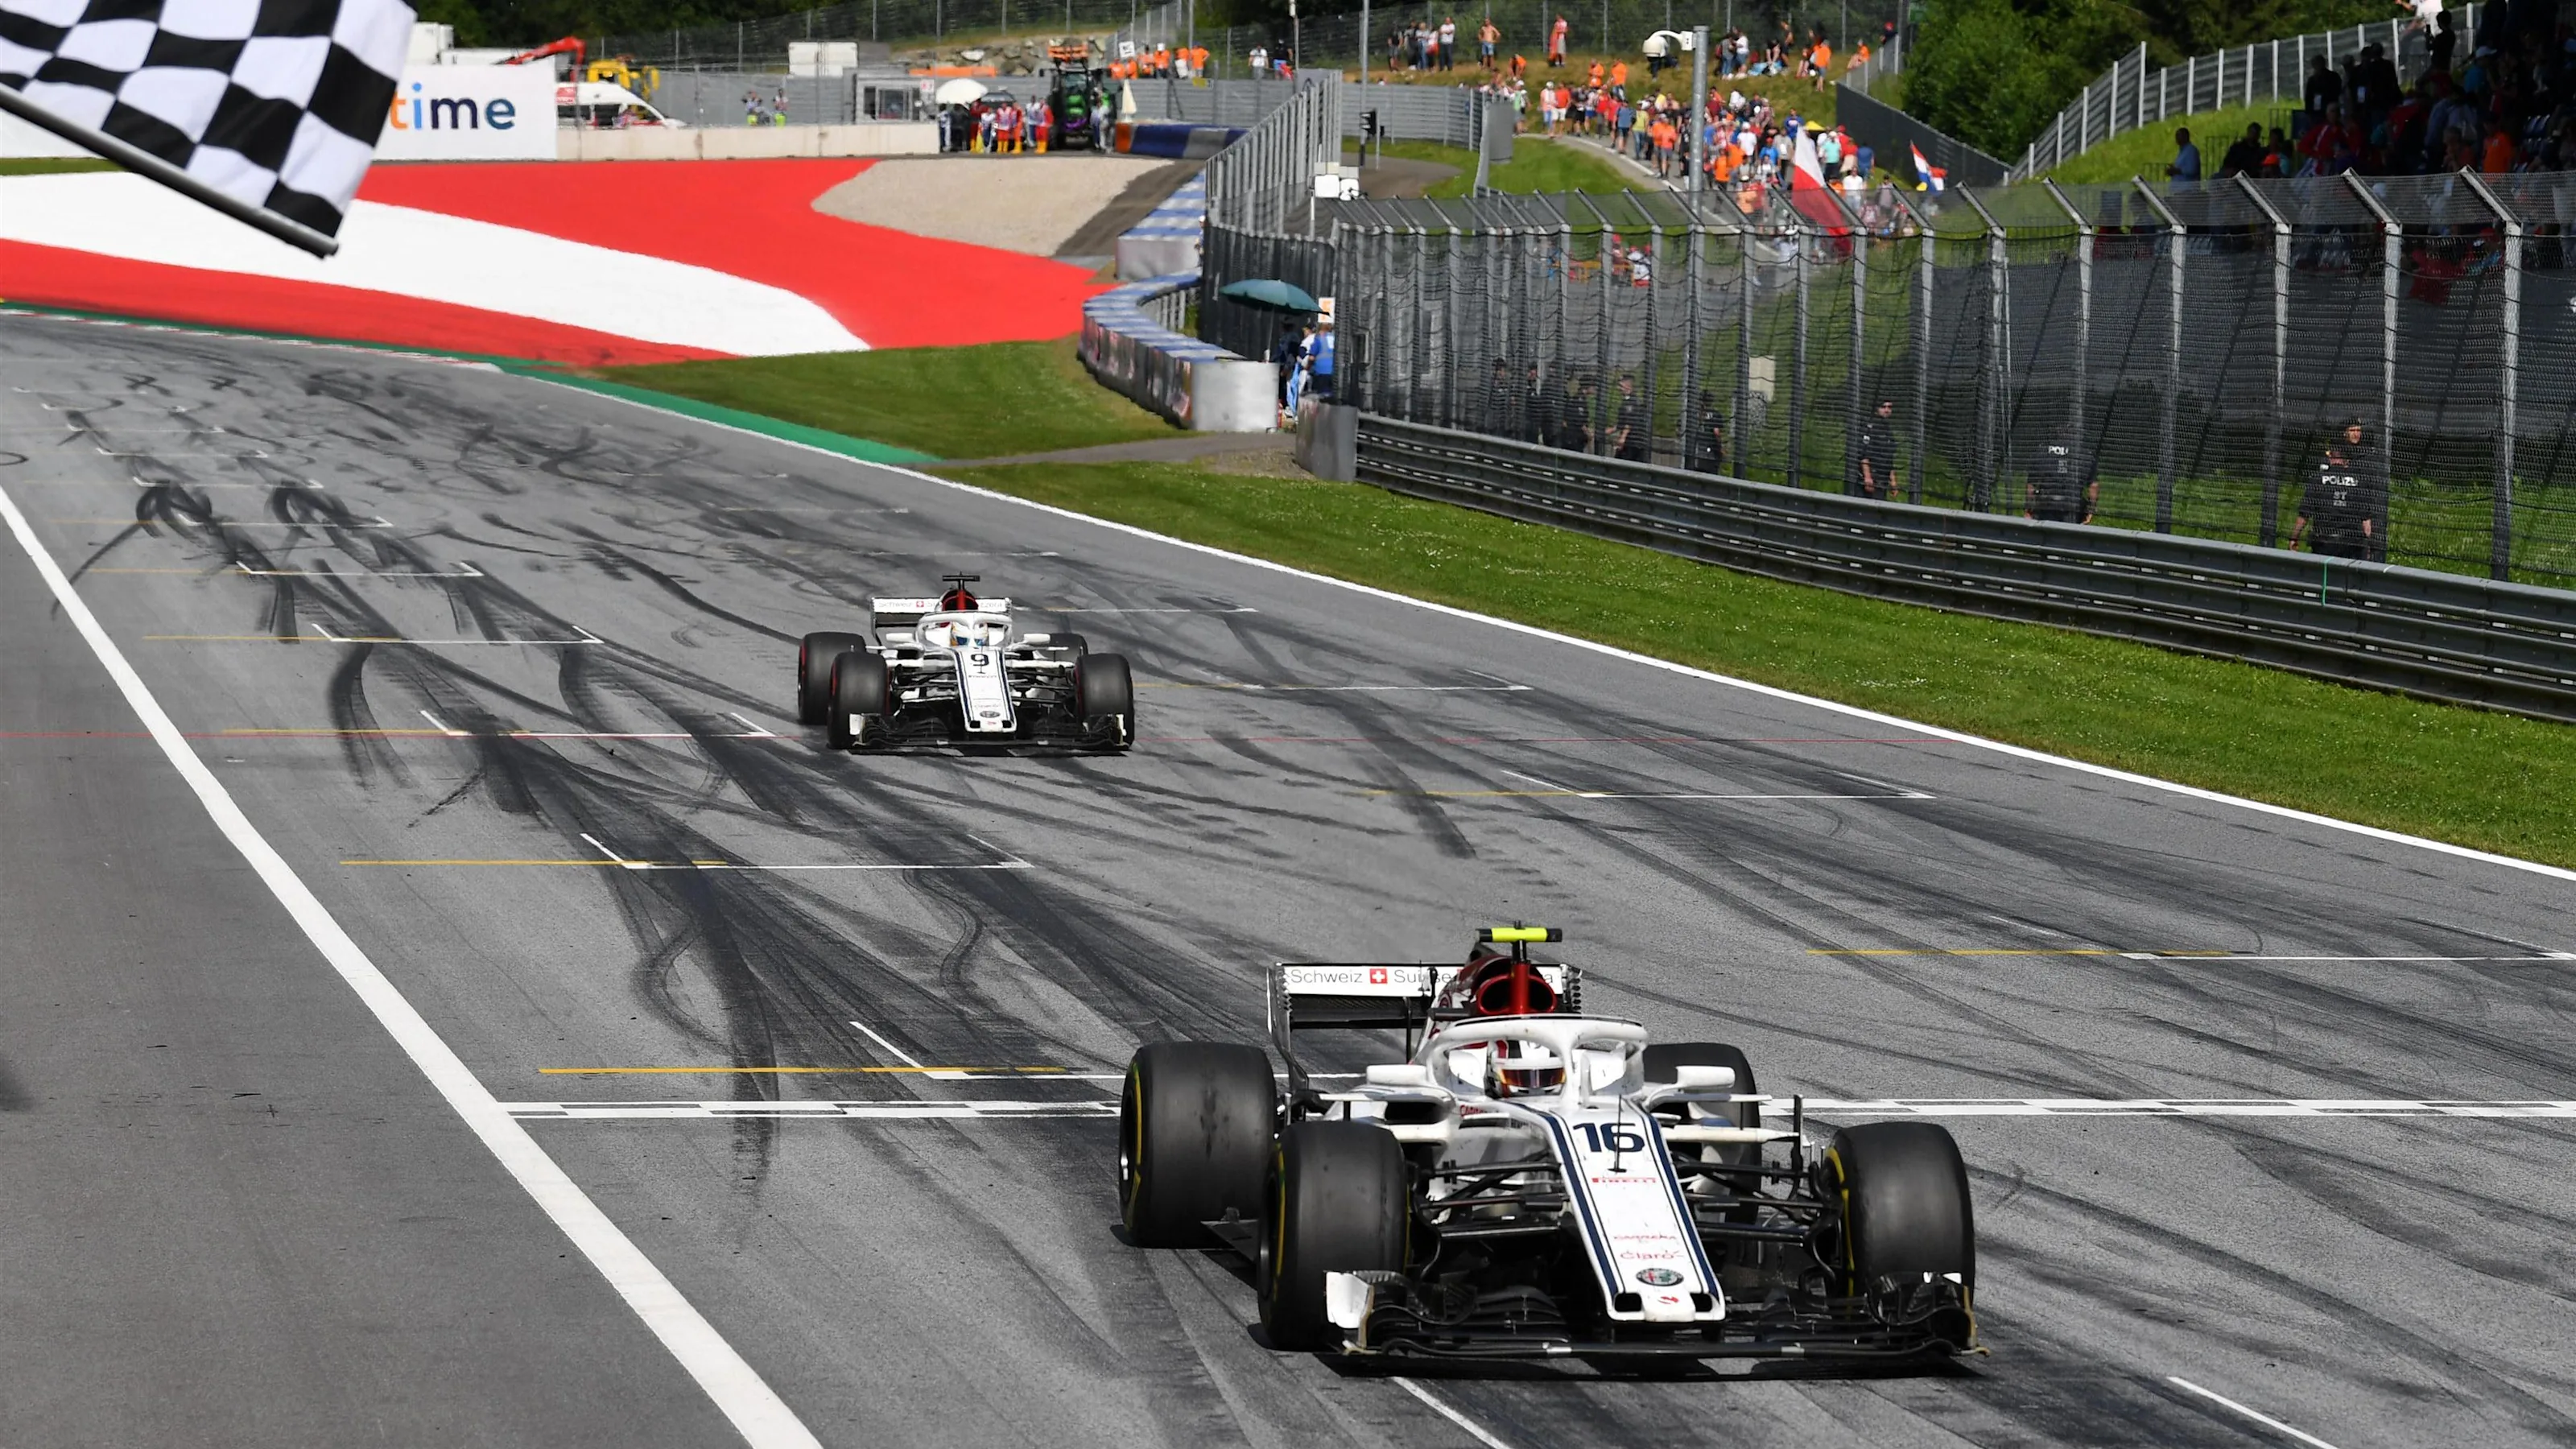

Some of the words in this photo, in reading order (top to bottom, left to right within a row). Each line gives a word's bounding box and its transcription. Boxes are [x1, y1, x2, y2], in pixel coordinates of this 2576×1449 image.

[390, 82, 515, 130] time
[971, 653, 989, 667] 9
[1290, 968, 1363, 984] Schweiz
[1572, 1122, 1645, 1153] 16
